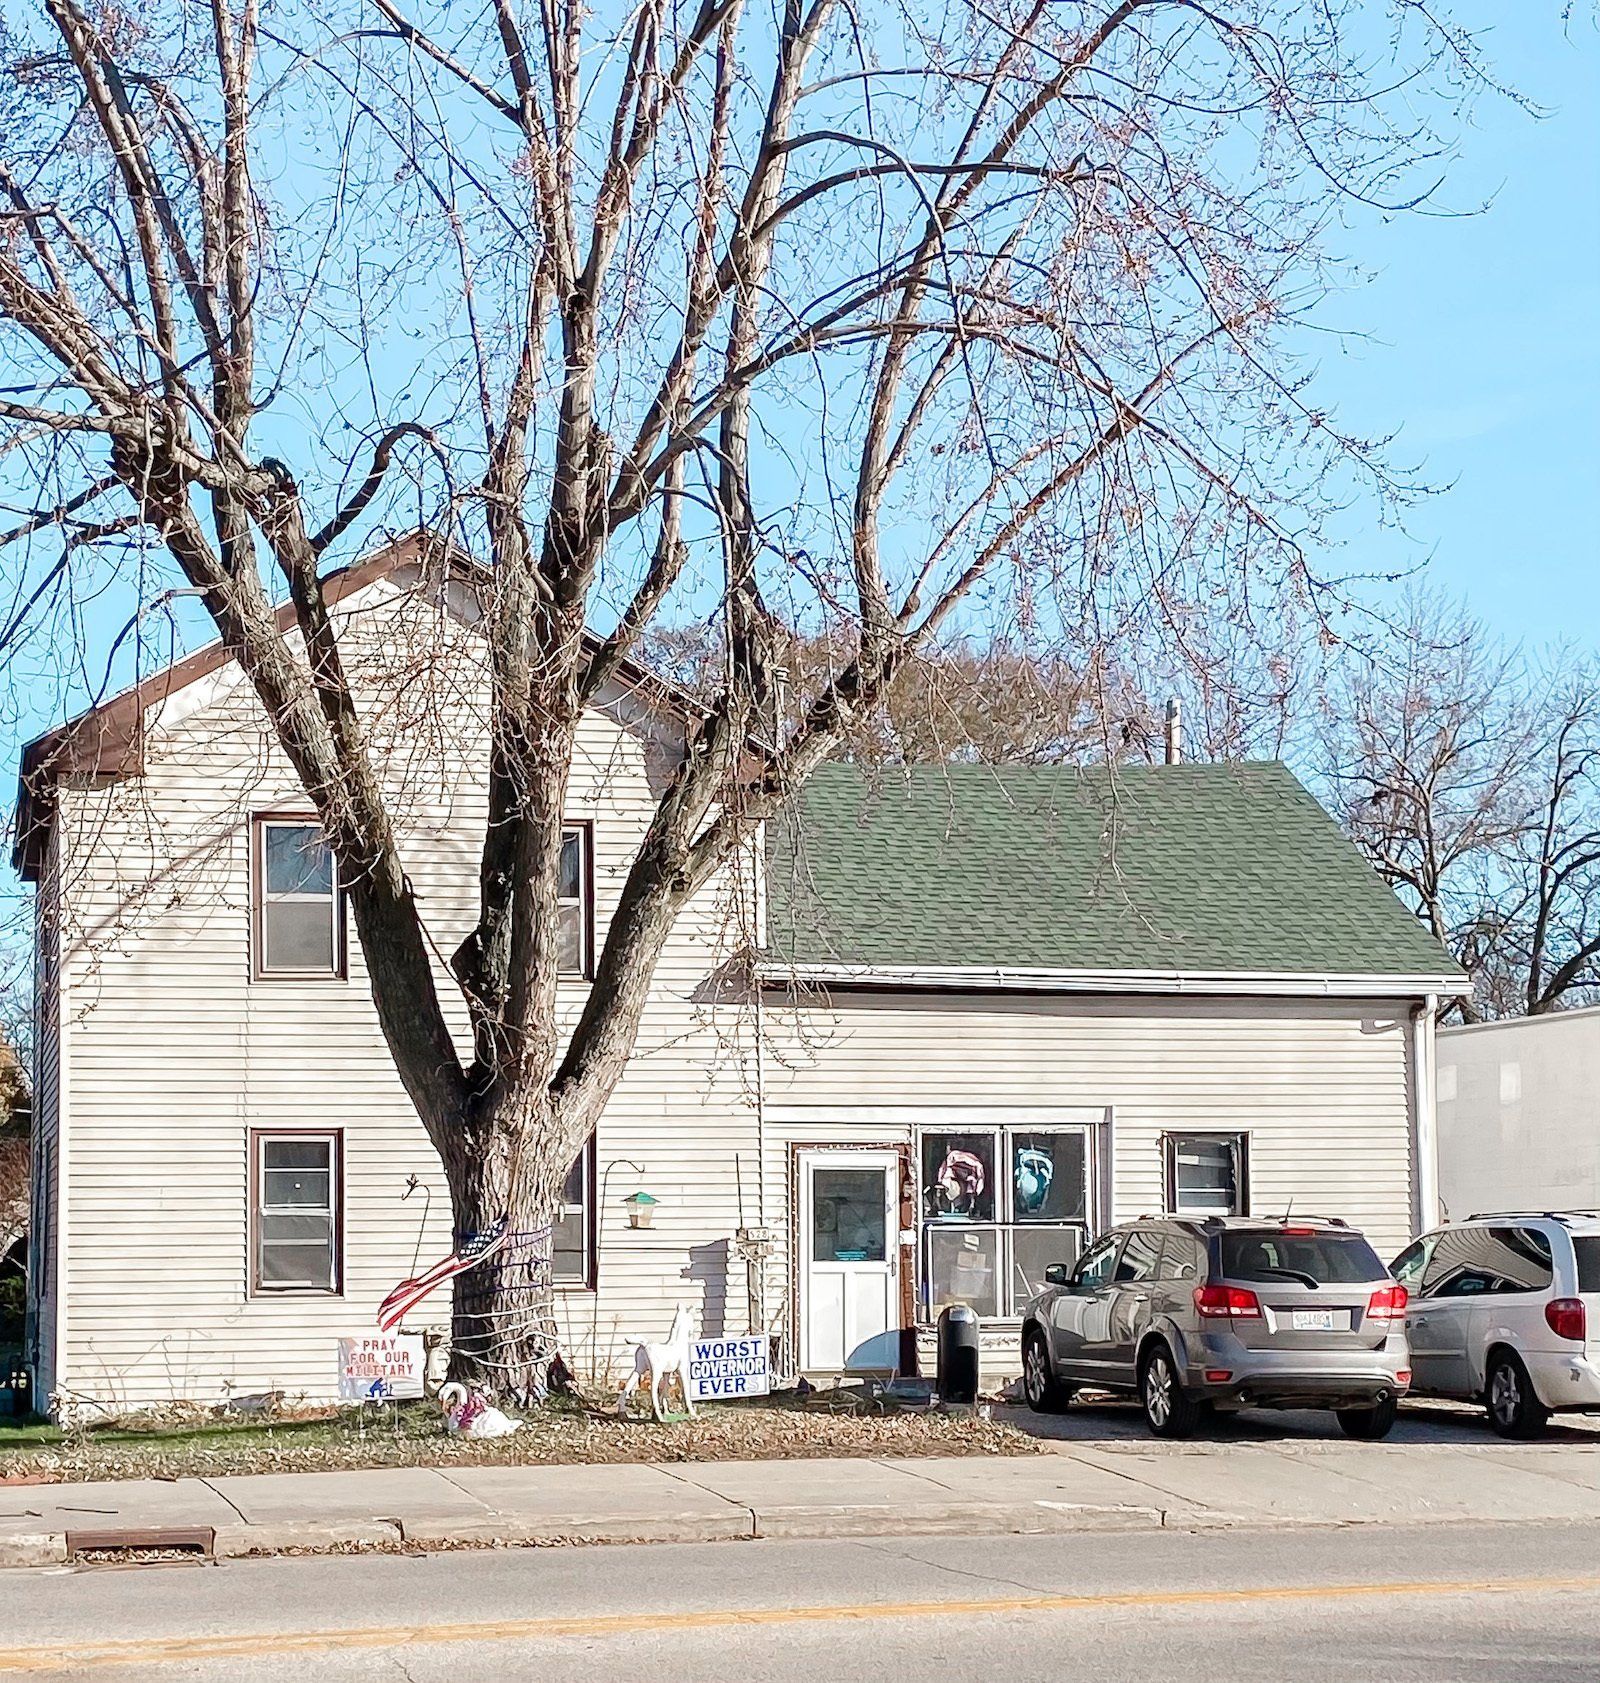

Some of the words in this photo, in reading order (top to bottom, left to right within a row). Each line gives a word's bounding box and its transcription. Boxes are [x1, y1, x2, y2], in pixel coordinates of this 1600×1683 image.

[363, 1339, 397, 1352] PRAY
[695, 1340, 762, 1360] WORST
[350, 1352, 375, 1365] FOR
[384, 1351, 410, 1363] OUR
[346, 1364, 414, 1377] MILITARY
[691, 1357, 766, 1379] GOVERNOR
